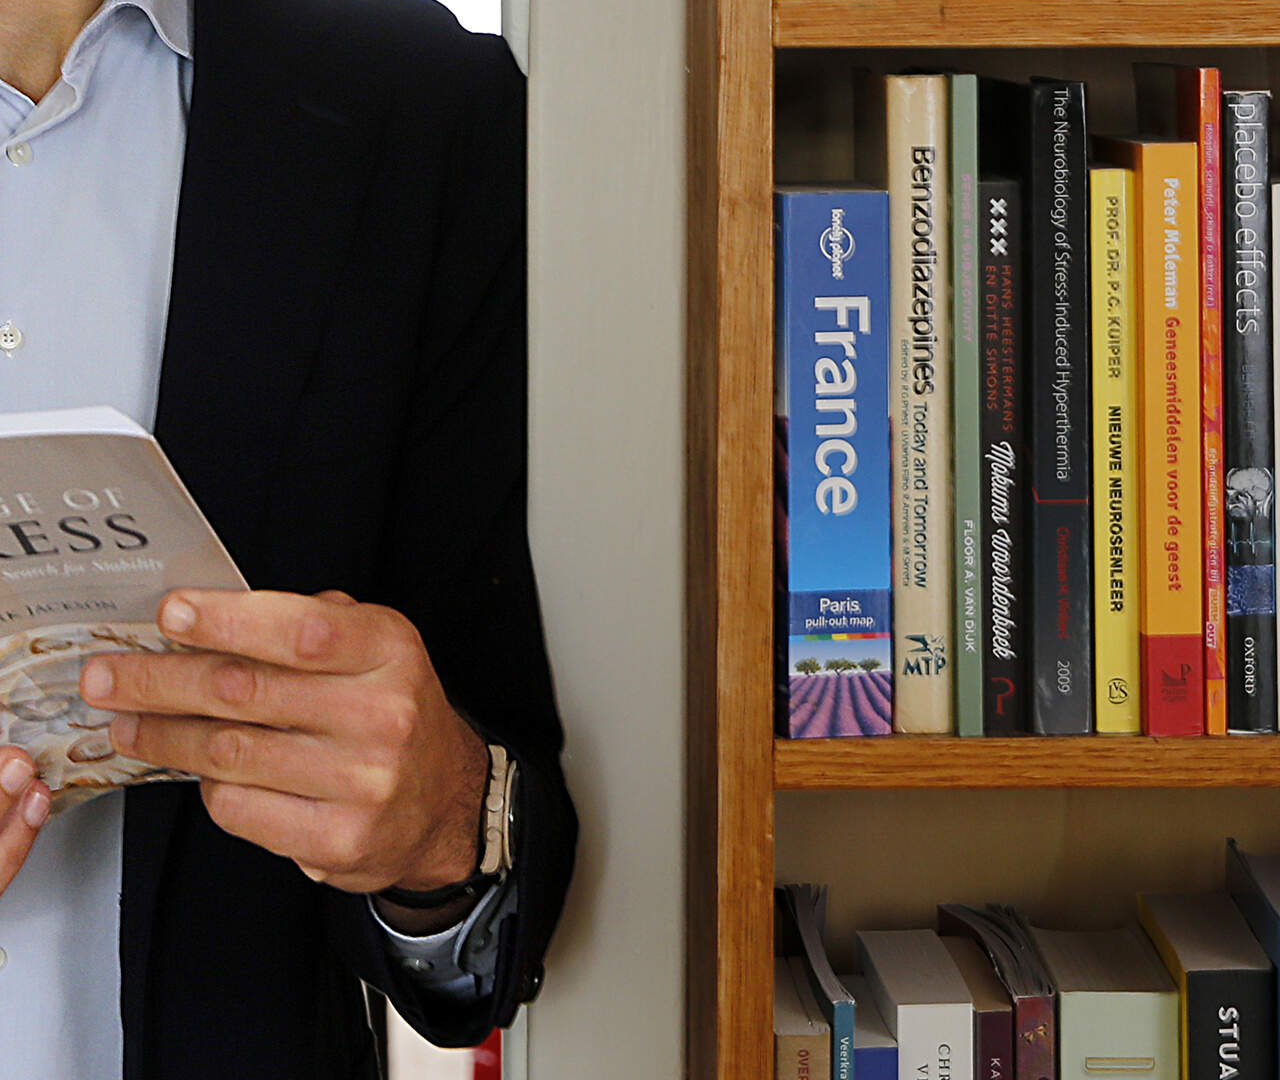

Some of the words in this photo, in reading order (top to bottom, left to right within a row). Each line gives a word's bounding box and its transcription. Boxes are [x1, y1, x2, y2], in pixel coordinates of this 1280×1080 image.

[1054, 88, 1070, 116] The
[1051, 121, 1070, 229] Neurobiology
[1229, 102, 1262, 219] placebo
[1162, 177, 1179, 224] Peter
[909, 146, 937, 395] Benzodiazepines
[1055, 233, 1070, 248] of
[1164, 228, 1180, 309] Moleman
[1055, 251, 1071, 367] Stress-Induced
[1234, 227, 1265, 334] effects
[814, 295, 870, 516] France
[911, 401, 930, 453] Today
[1051, 371, 1072, 480] Hyperthermia
[1163, 317, 1182, 465] Geneesmiddelen
[914, 458, 930, 489] and
[1108, 406, 1123, 471] NIEUWE
[63, 487, 125, 511] OF
[986, 441, 1015, 524] Mokums
[1167, 470, 1179, 510] voor
[915, 495, 931, 588] Tomorrow
[1109, 476, 1124, 612] NEUROSENLEER
[1167, 517, 1182, 535] de
[990, 530, 1016, 660] woordenboek
[1162, 541, 1182, 592] geest
[25, 598, 118, 618] JACKSON
[819, 598, 862, 611] Paris
[1056, 660, 1072, 693] 2009
